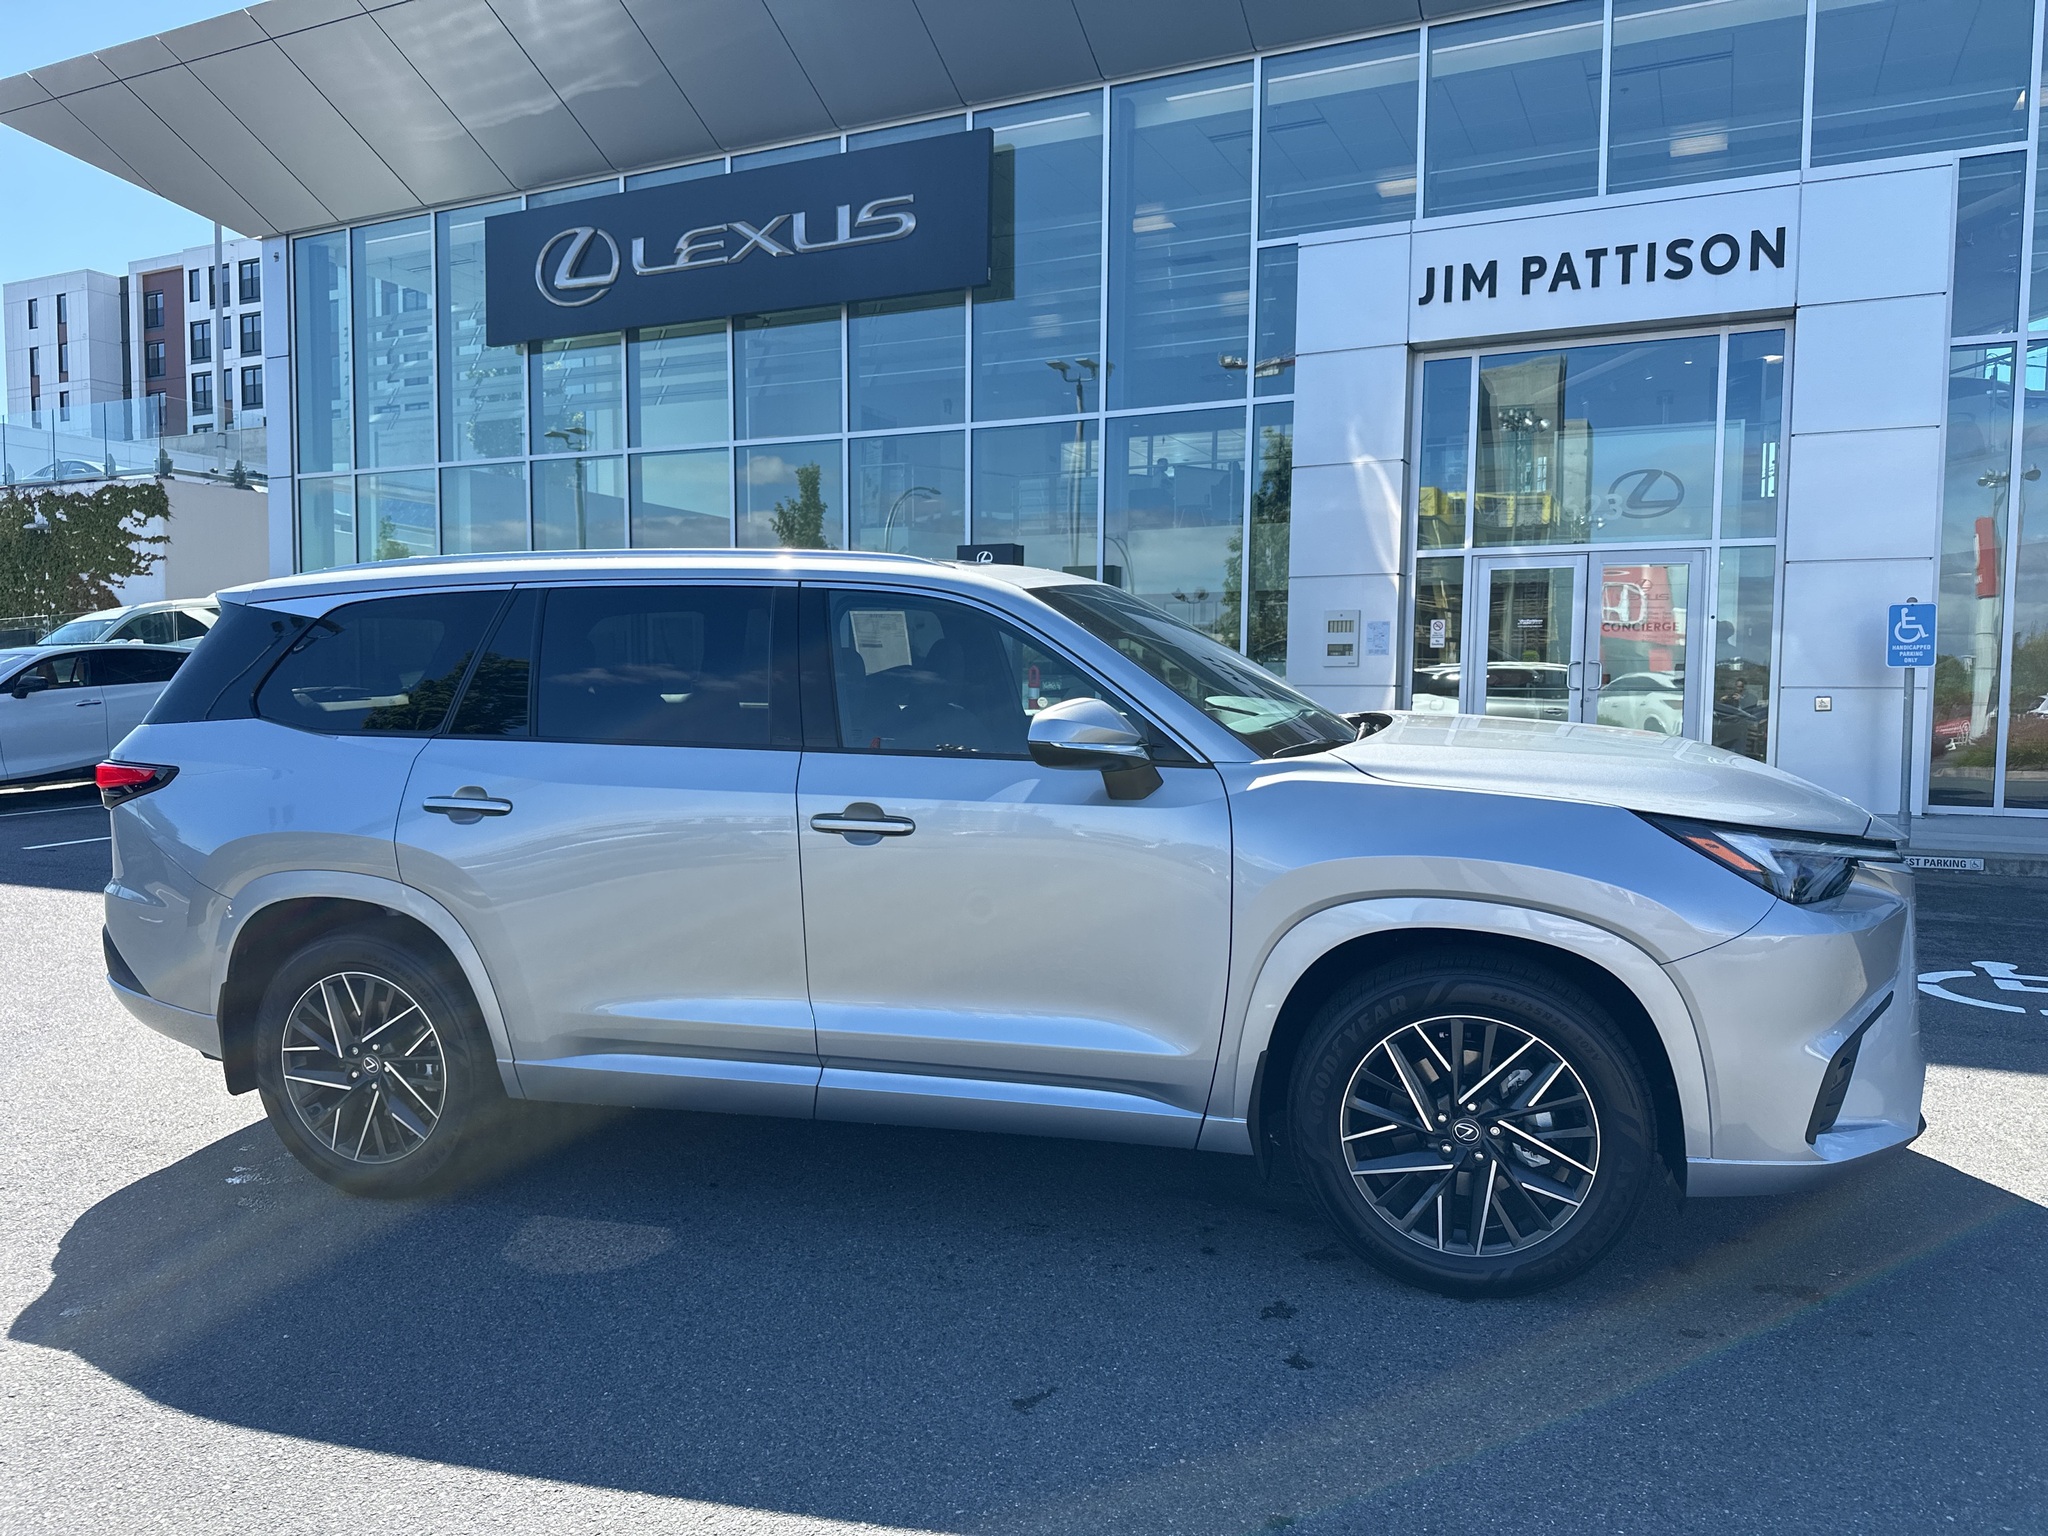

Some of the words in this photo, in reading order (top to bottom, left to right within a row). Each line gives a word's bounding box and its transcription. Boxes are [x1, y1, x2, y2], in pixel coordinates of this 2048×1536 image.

[631, 194, 917, 276] LEXUS
[1418, 260, 1498, 306] JIM
[1522, 226, 1786, 296] PATTISON
[1601, 622, 1681, 633] CONCIERGE
[1923, 858, 1967, 869] PARKING
[1308, 994, 1409, 1125] GOODYEAR
